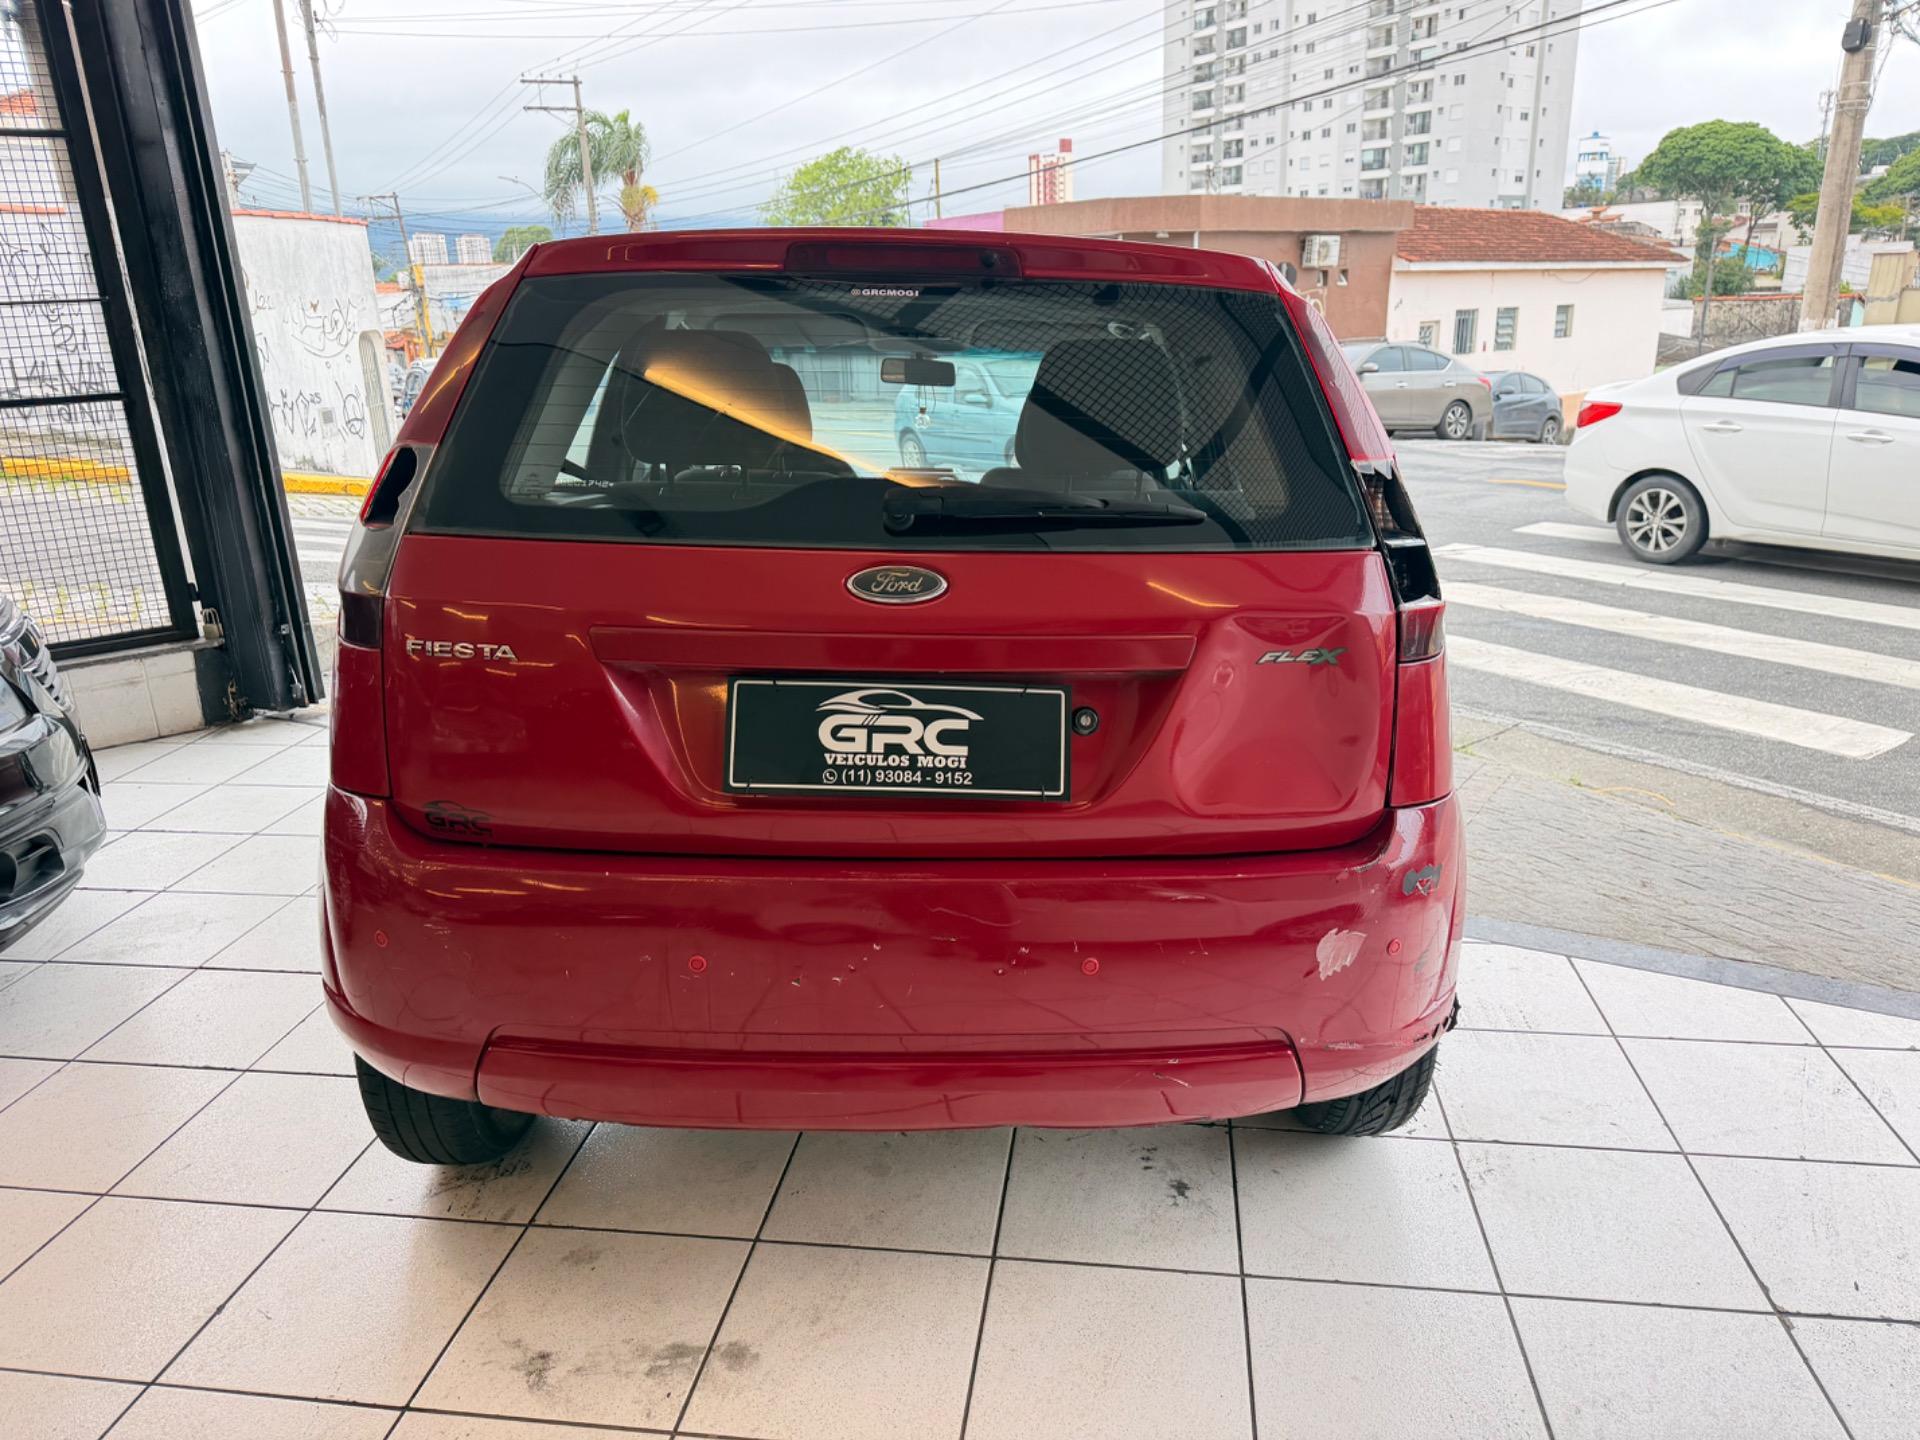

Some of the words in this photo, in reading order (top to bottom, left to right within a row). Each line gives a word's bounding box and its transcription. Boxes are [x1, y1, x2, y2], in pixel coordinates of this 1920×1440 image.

[871, 572, 923, 593] Ford
[405, 638, 518, 662] FIESTA
[1256, 647, 1347, 666] FLEX
[818, 714, 969, 756] GRC
[823, 752, 910, 767] VEICULOS
[916, 755, 967, 769] MOGI
[842, 768, 871, 785] (11)
[875, 769, 922, 783] 93084
[935, 771, 973, 785] 9152
[424, 812, 493, 833] GRC
